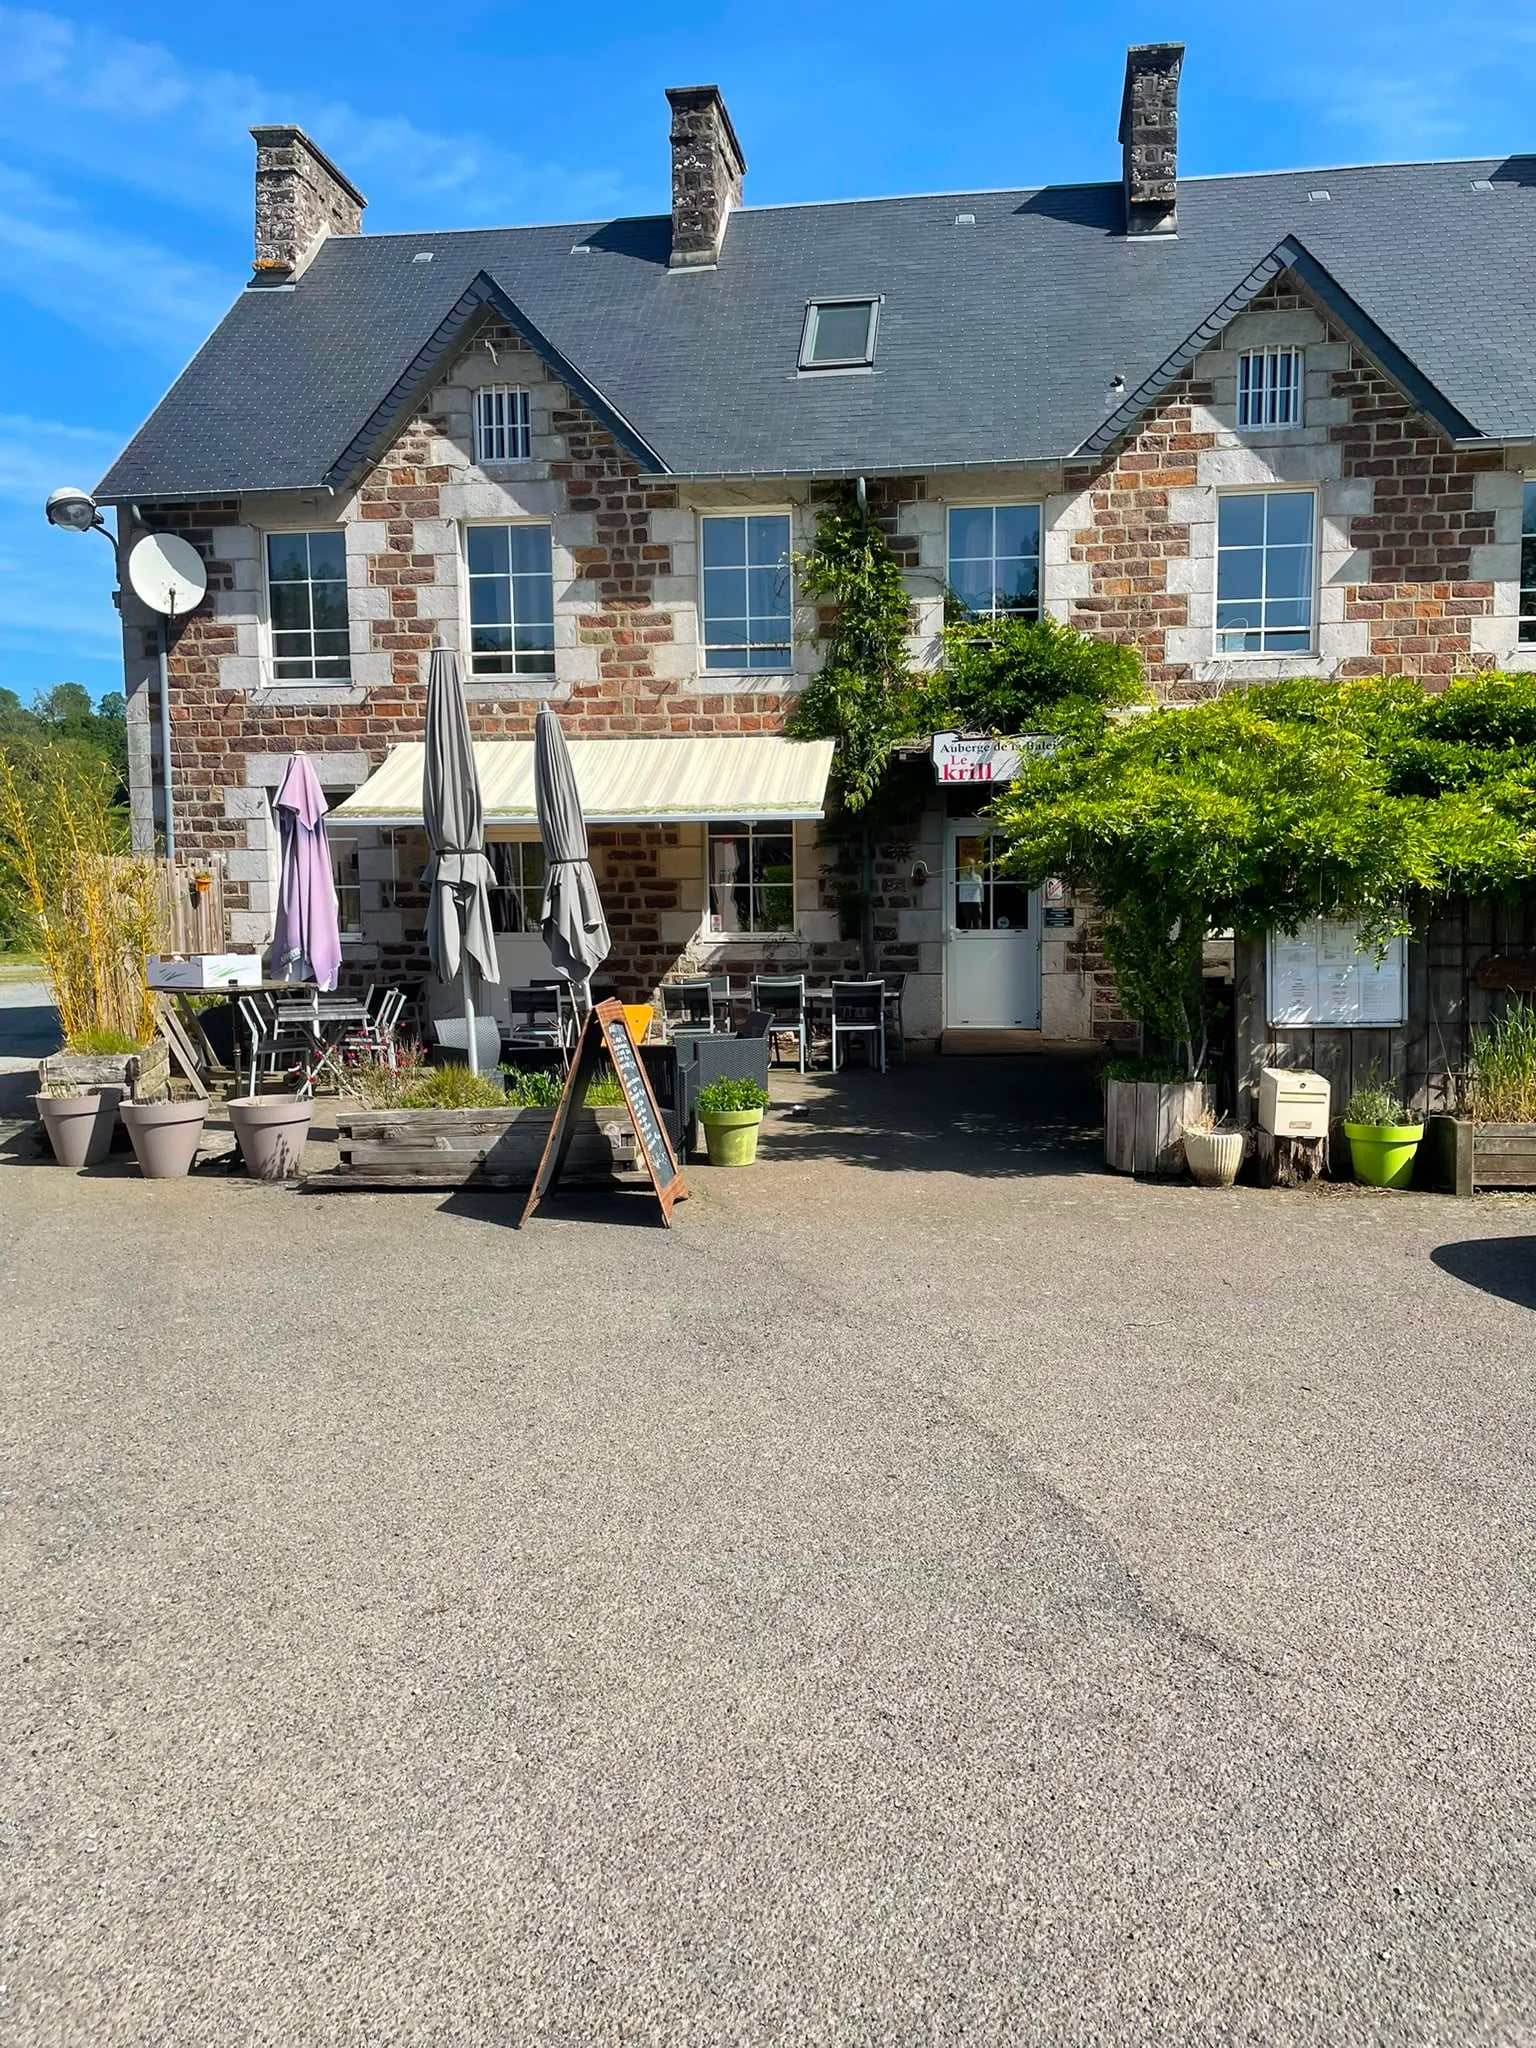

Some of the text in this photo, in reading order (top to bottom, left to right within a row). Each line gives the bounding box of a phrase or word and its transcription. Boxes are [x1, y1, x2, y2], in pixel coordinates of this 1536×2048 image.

[940, 743, 990, 753] Auberge
[993, 743, 1008, 751] de
[951, 755, 968, 765] Le
[943, 762, 992, 781] krill
